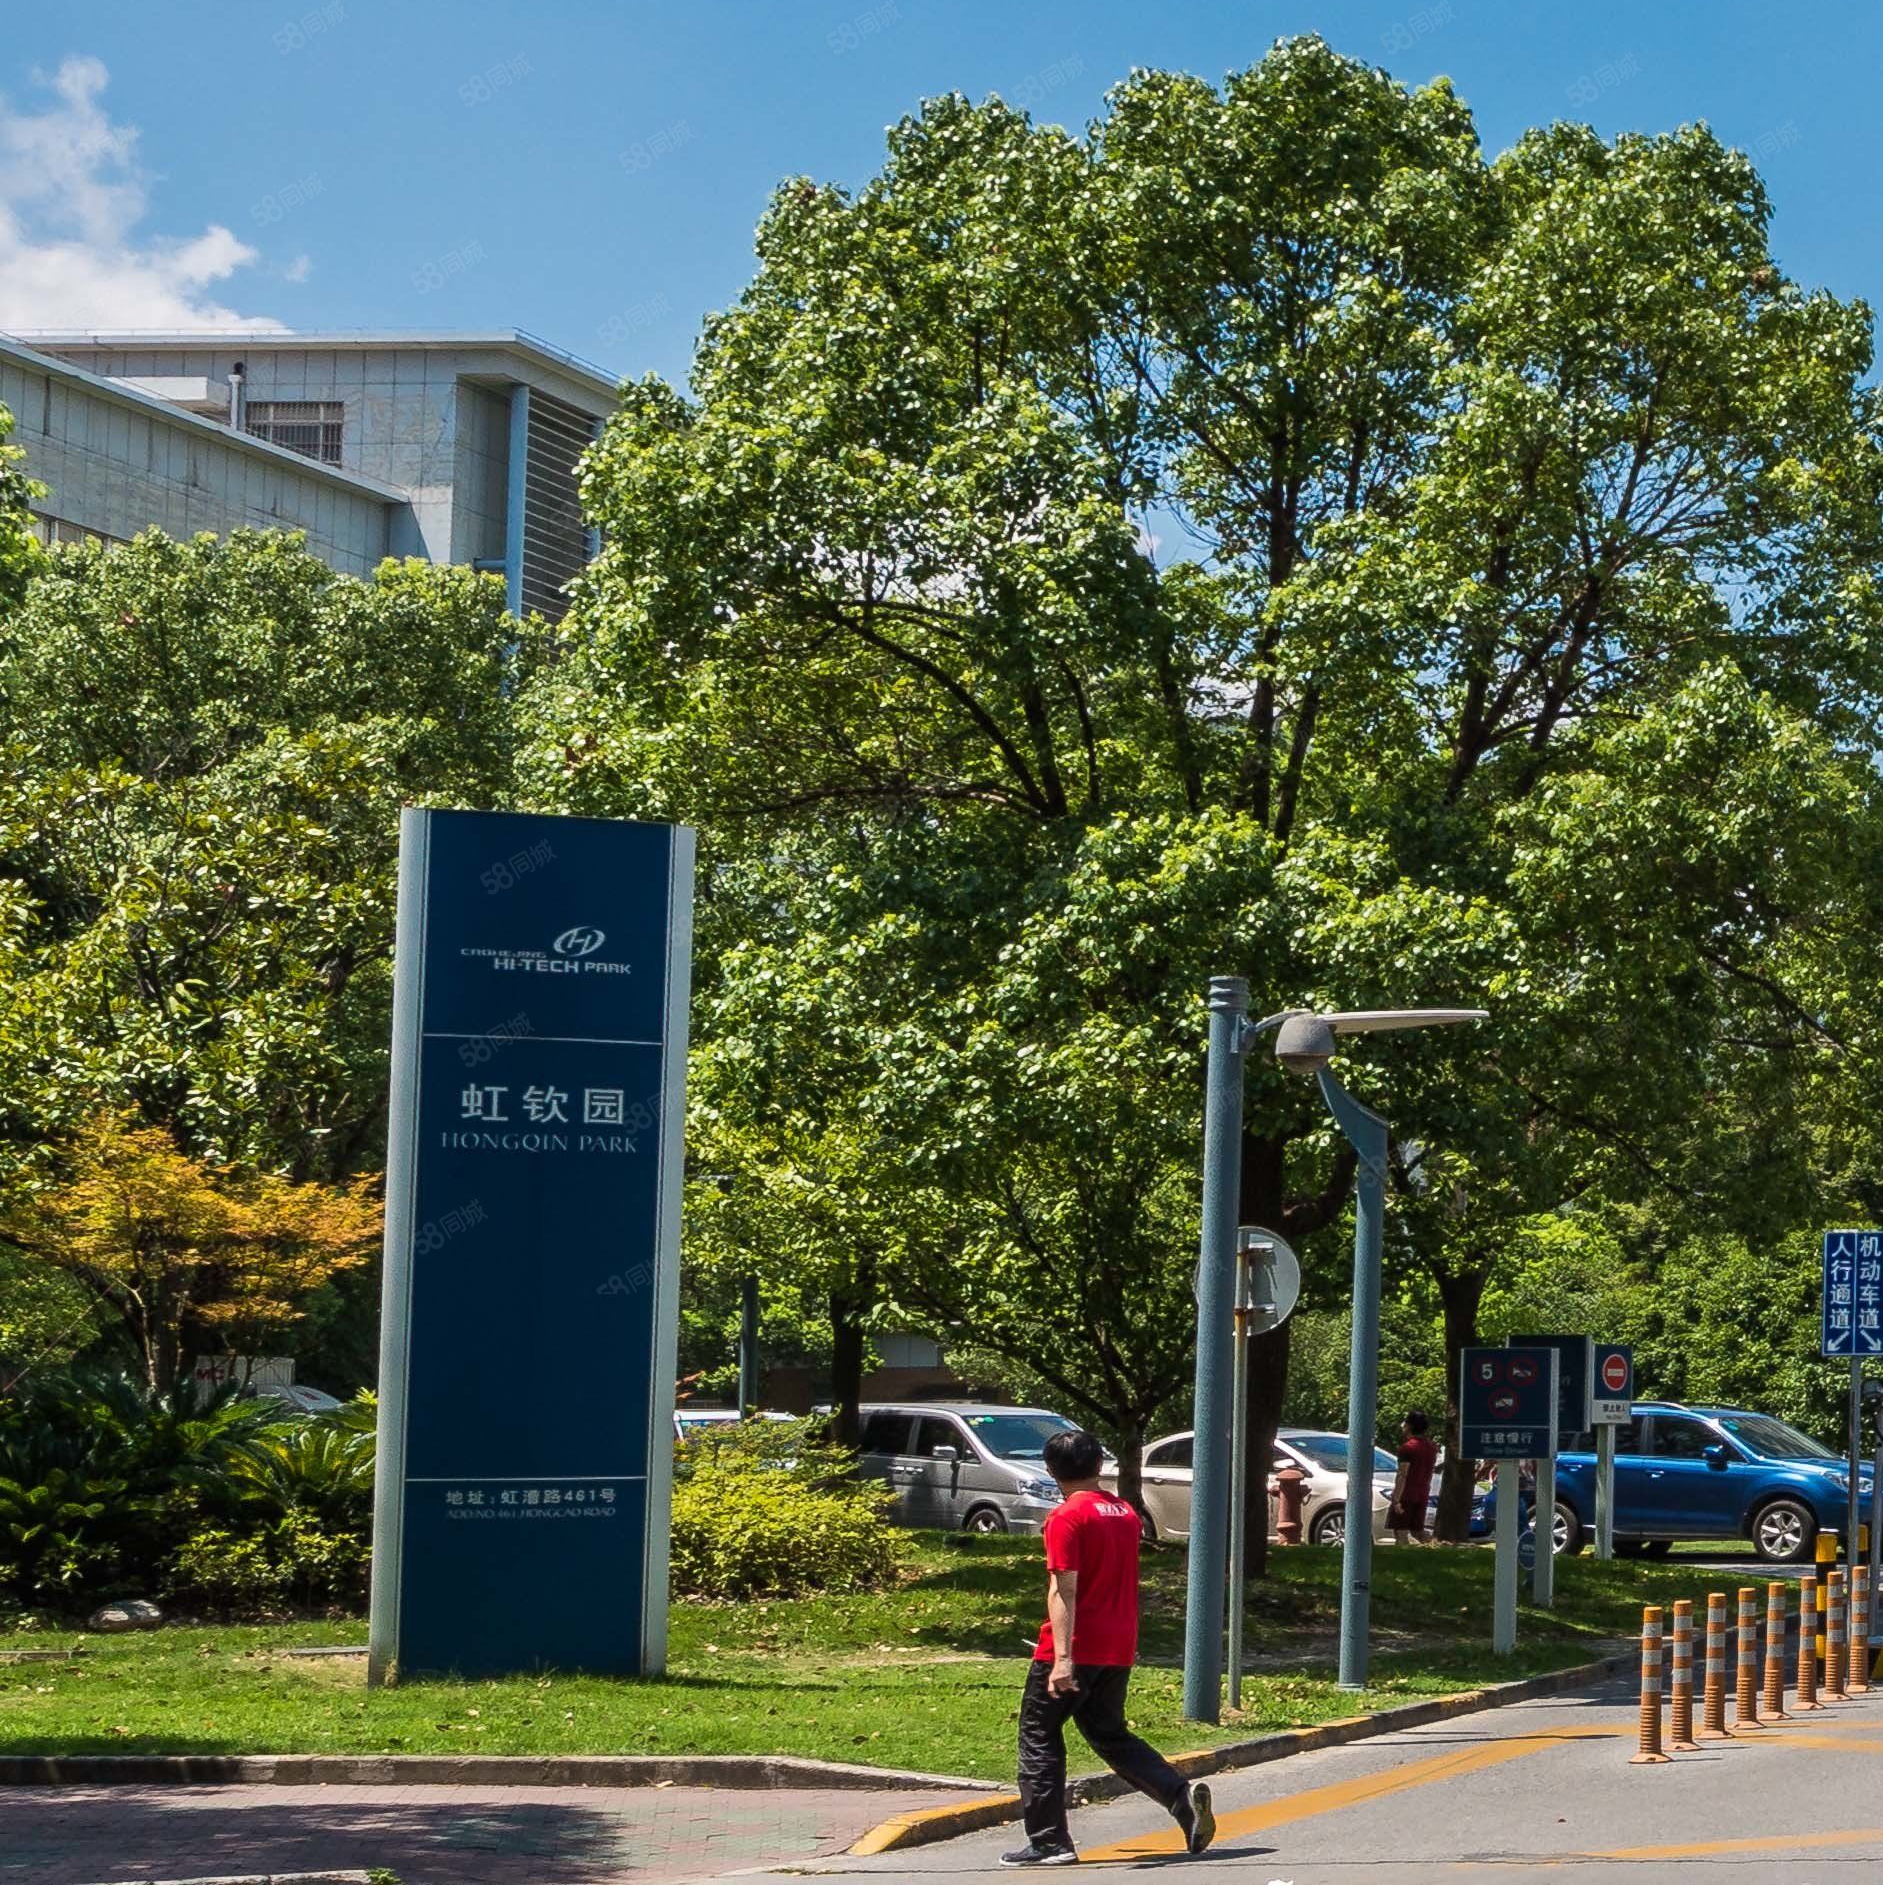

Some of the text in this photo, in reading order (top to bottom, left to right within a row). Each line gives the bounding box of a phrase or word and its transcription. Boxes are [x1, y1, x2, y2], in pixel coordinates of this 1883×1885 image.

[493, 956, 632, 975] HI-TECH PARK
[461, 1083, 625, 1125] 虹钦园
[441, 1131, 639, 1154] HONGQIN PARK
[1830, 1235, 1852, 1329] 人行通道
[1859, 1235, 1882, 1329] 机动车道
[1482, 1364, 1493, 1380] 5
